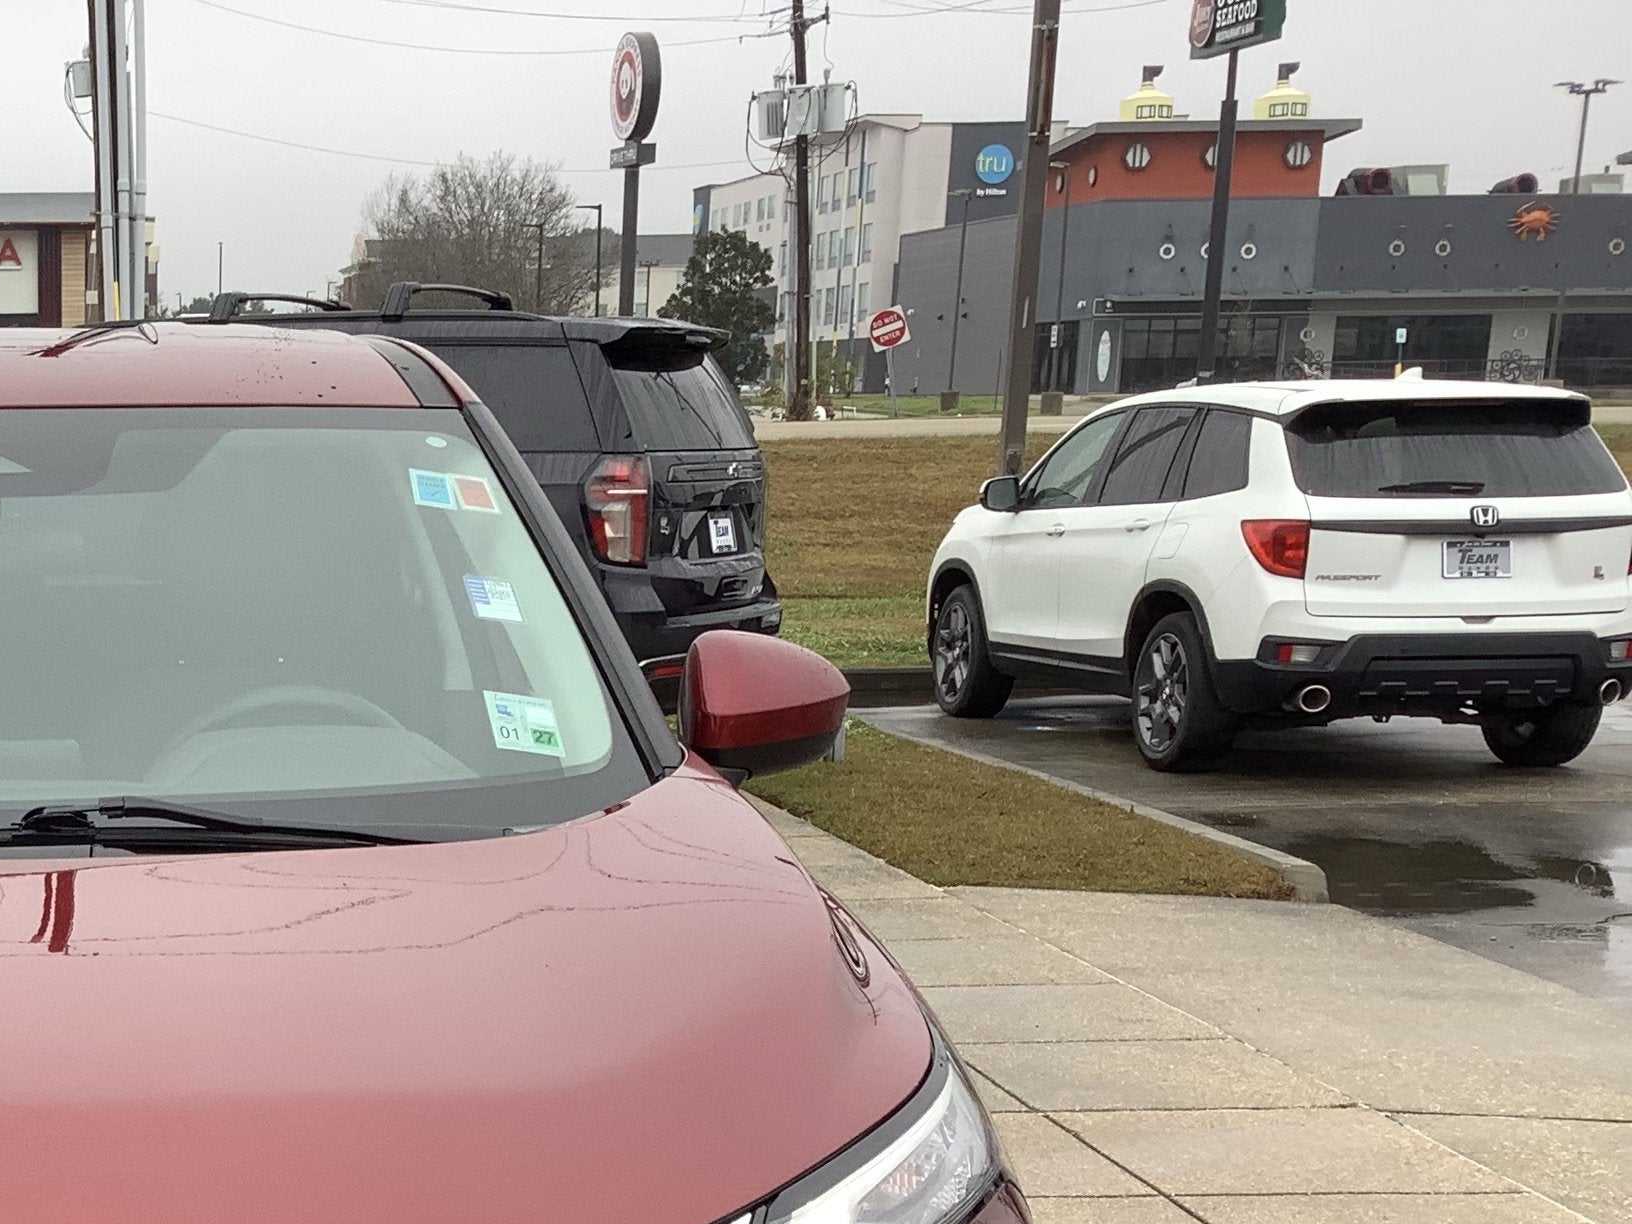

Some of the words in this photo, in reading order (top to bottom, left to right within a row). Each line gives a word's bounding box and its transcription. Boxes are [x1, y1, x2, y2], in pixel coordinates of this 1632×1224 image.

[1216, 0, 1258, 28] SEAFOOD
[977, 152, 1007, 173] tru
[872, 320, 883, 329] DO
[883, 313, 898, 324] NOT
[879, 330, 901, 343] ENTER
[1458, 548, 1499, 565] TEAM
[499, 725, 520, 741] 01
[532, 729, 554, 745] 27
